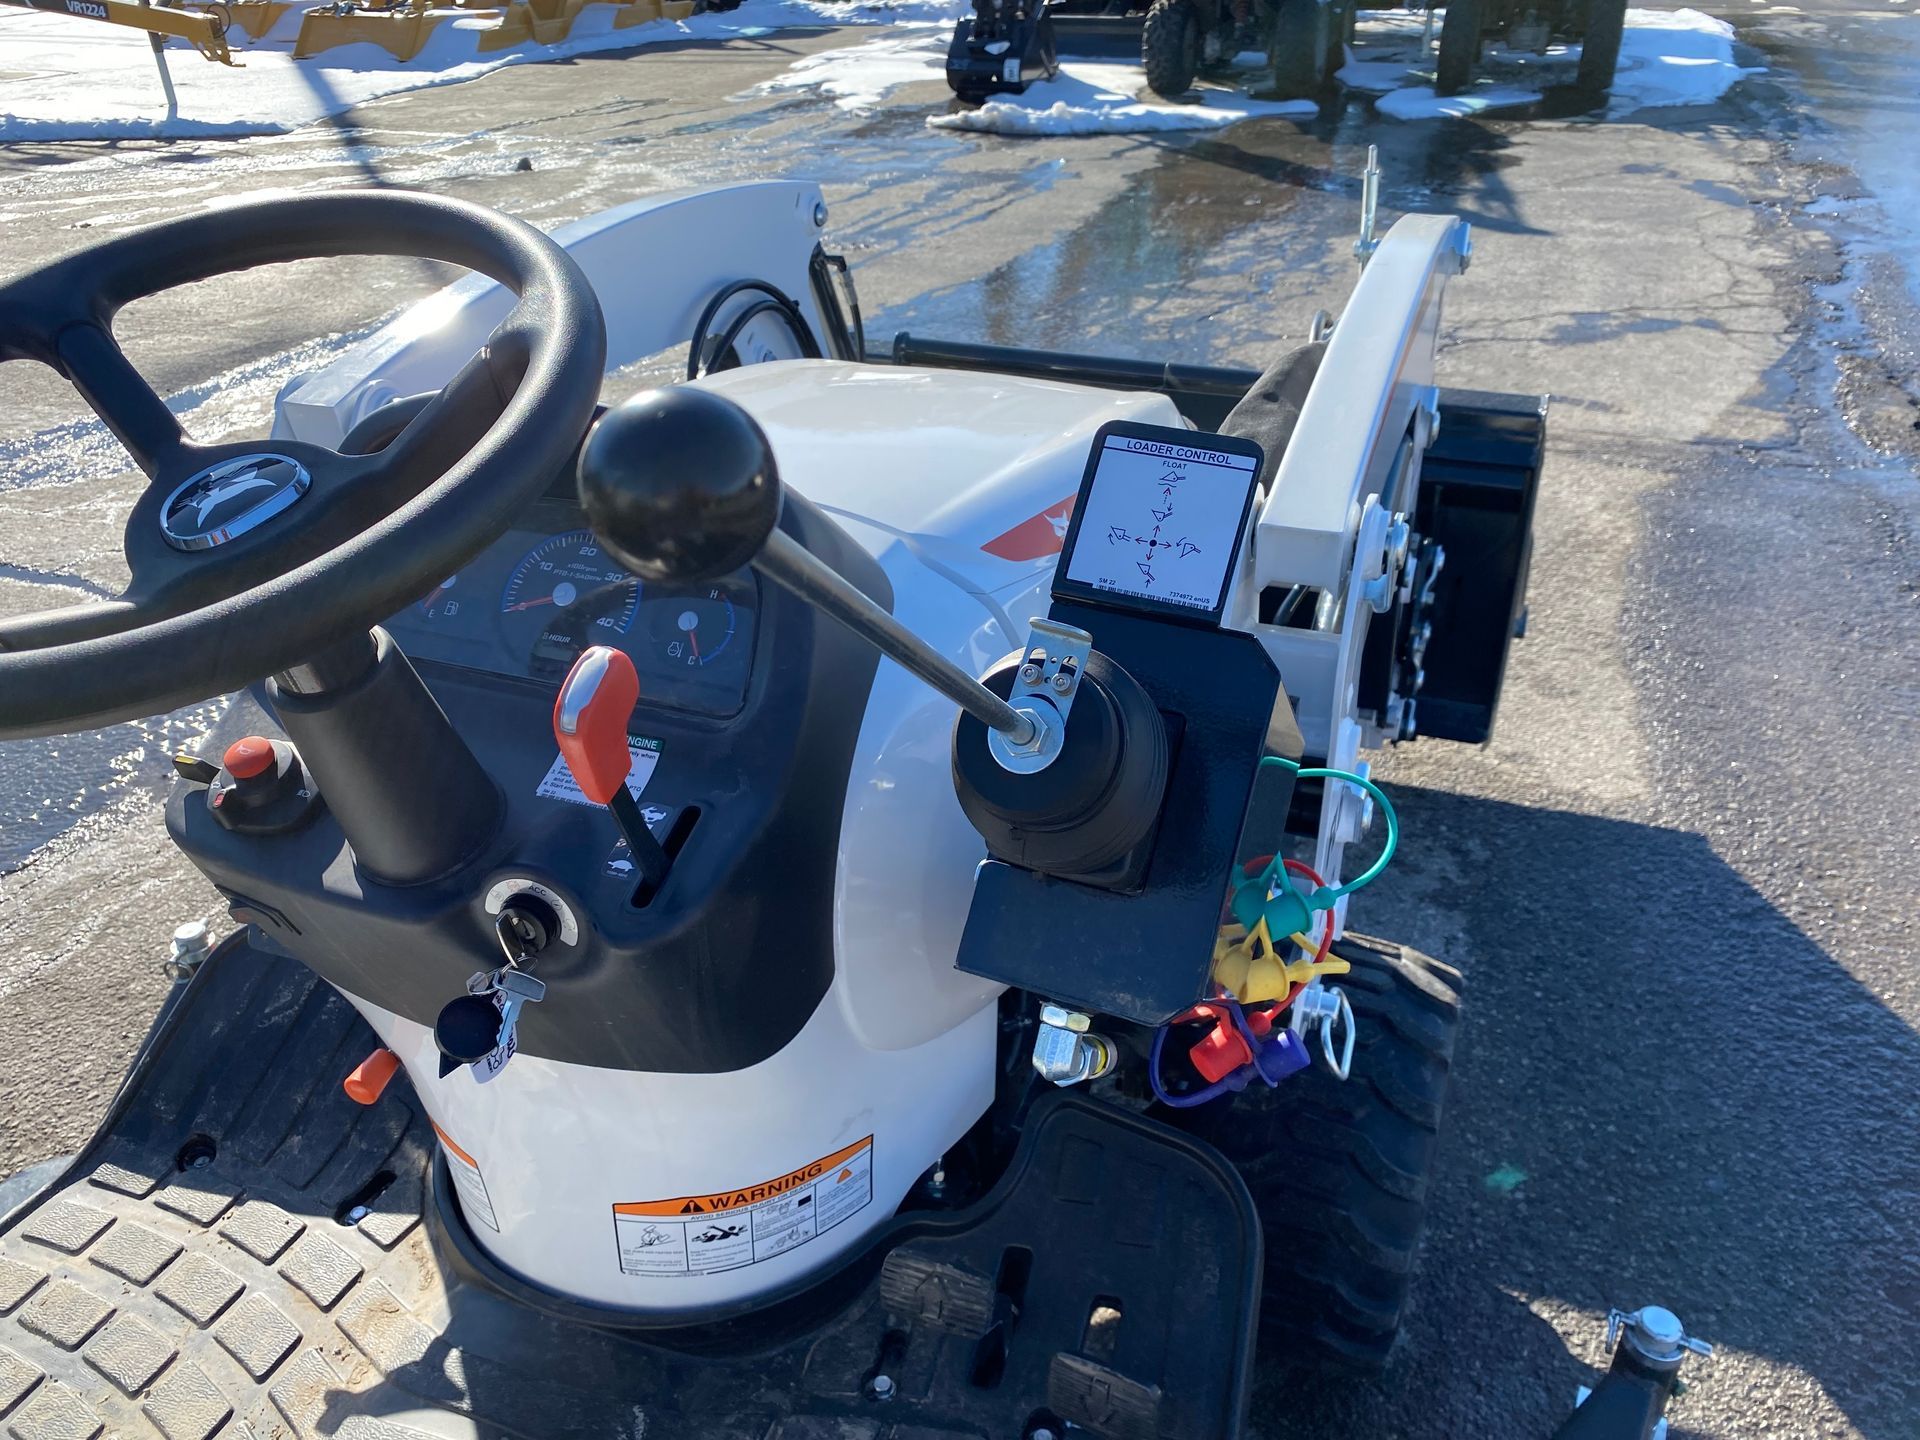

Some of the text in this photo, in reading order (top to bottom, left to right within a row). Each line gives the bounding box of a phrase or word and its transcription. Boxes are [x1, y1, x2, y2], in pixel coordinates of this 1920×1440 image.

[66, 0, 107, 18] VR1224
[1127, 440, 1232, 465] LOADER CONTROL
[1162, 460, 1187, 470] FLOAT
[579, 546, 598, 556] 20
[540, 561, 554, 571] 10
[604, 572, 623, 582] 30
[709, 588, 719, 599] H
[428, 608, 436, 618] E
[596, 617, 615, 627] 40
[548, 633, 571, 643] HOUR
[687, 655, 696, 665] C
[627, 735, 659, 750] NGINE
[528, 884, 547, 897] ACC
[708, 1163, 823, 1210] WARNING
[715, 1206, 749, 1217] SERIOUS
[750, 1198, 777, 1210] INJURY
